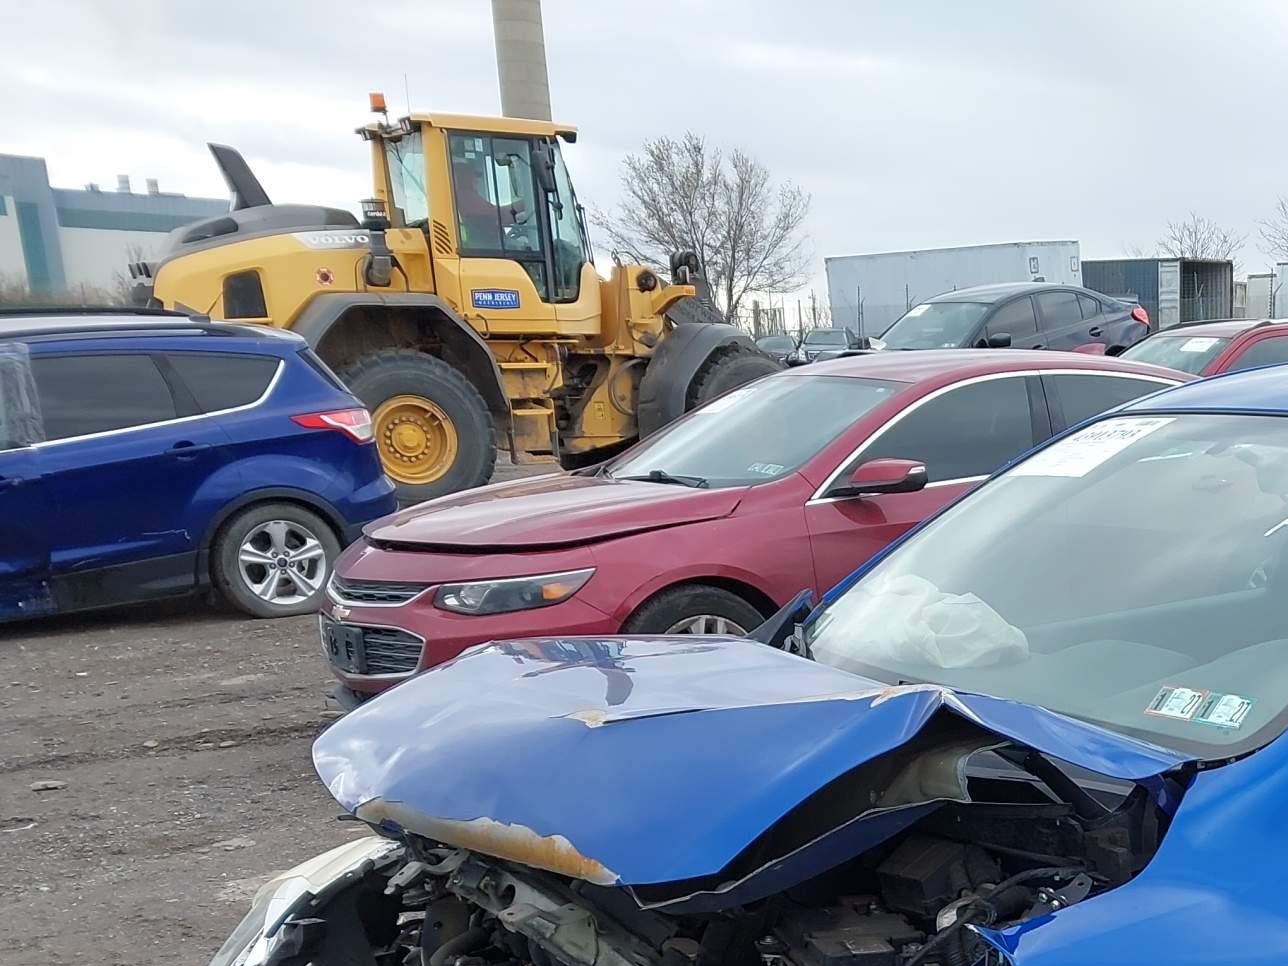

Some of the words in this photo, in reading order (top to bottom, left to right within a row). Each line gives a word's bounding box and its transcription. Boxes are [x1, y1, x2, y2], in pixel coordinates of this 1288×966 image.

[308, 235, 369, 244] VOLVO
[474, 292, 493, 300] PENN
[494, 293, 516, 302] JERSEY
